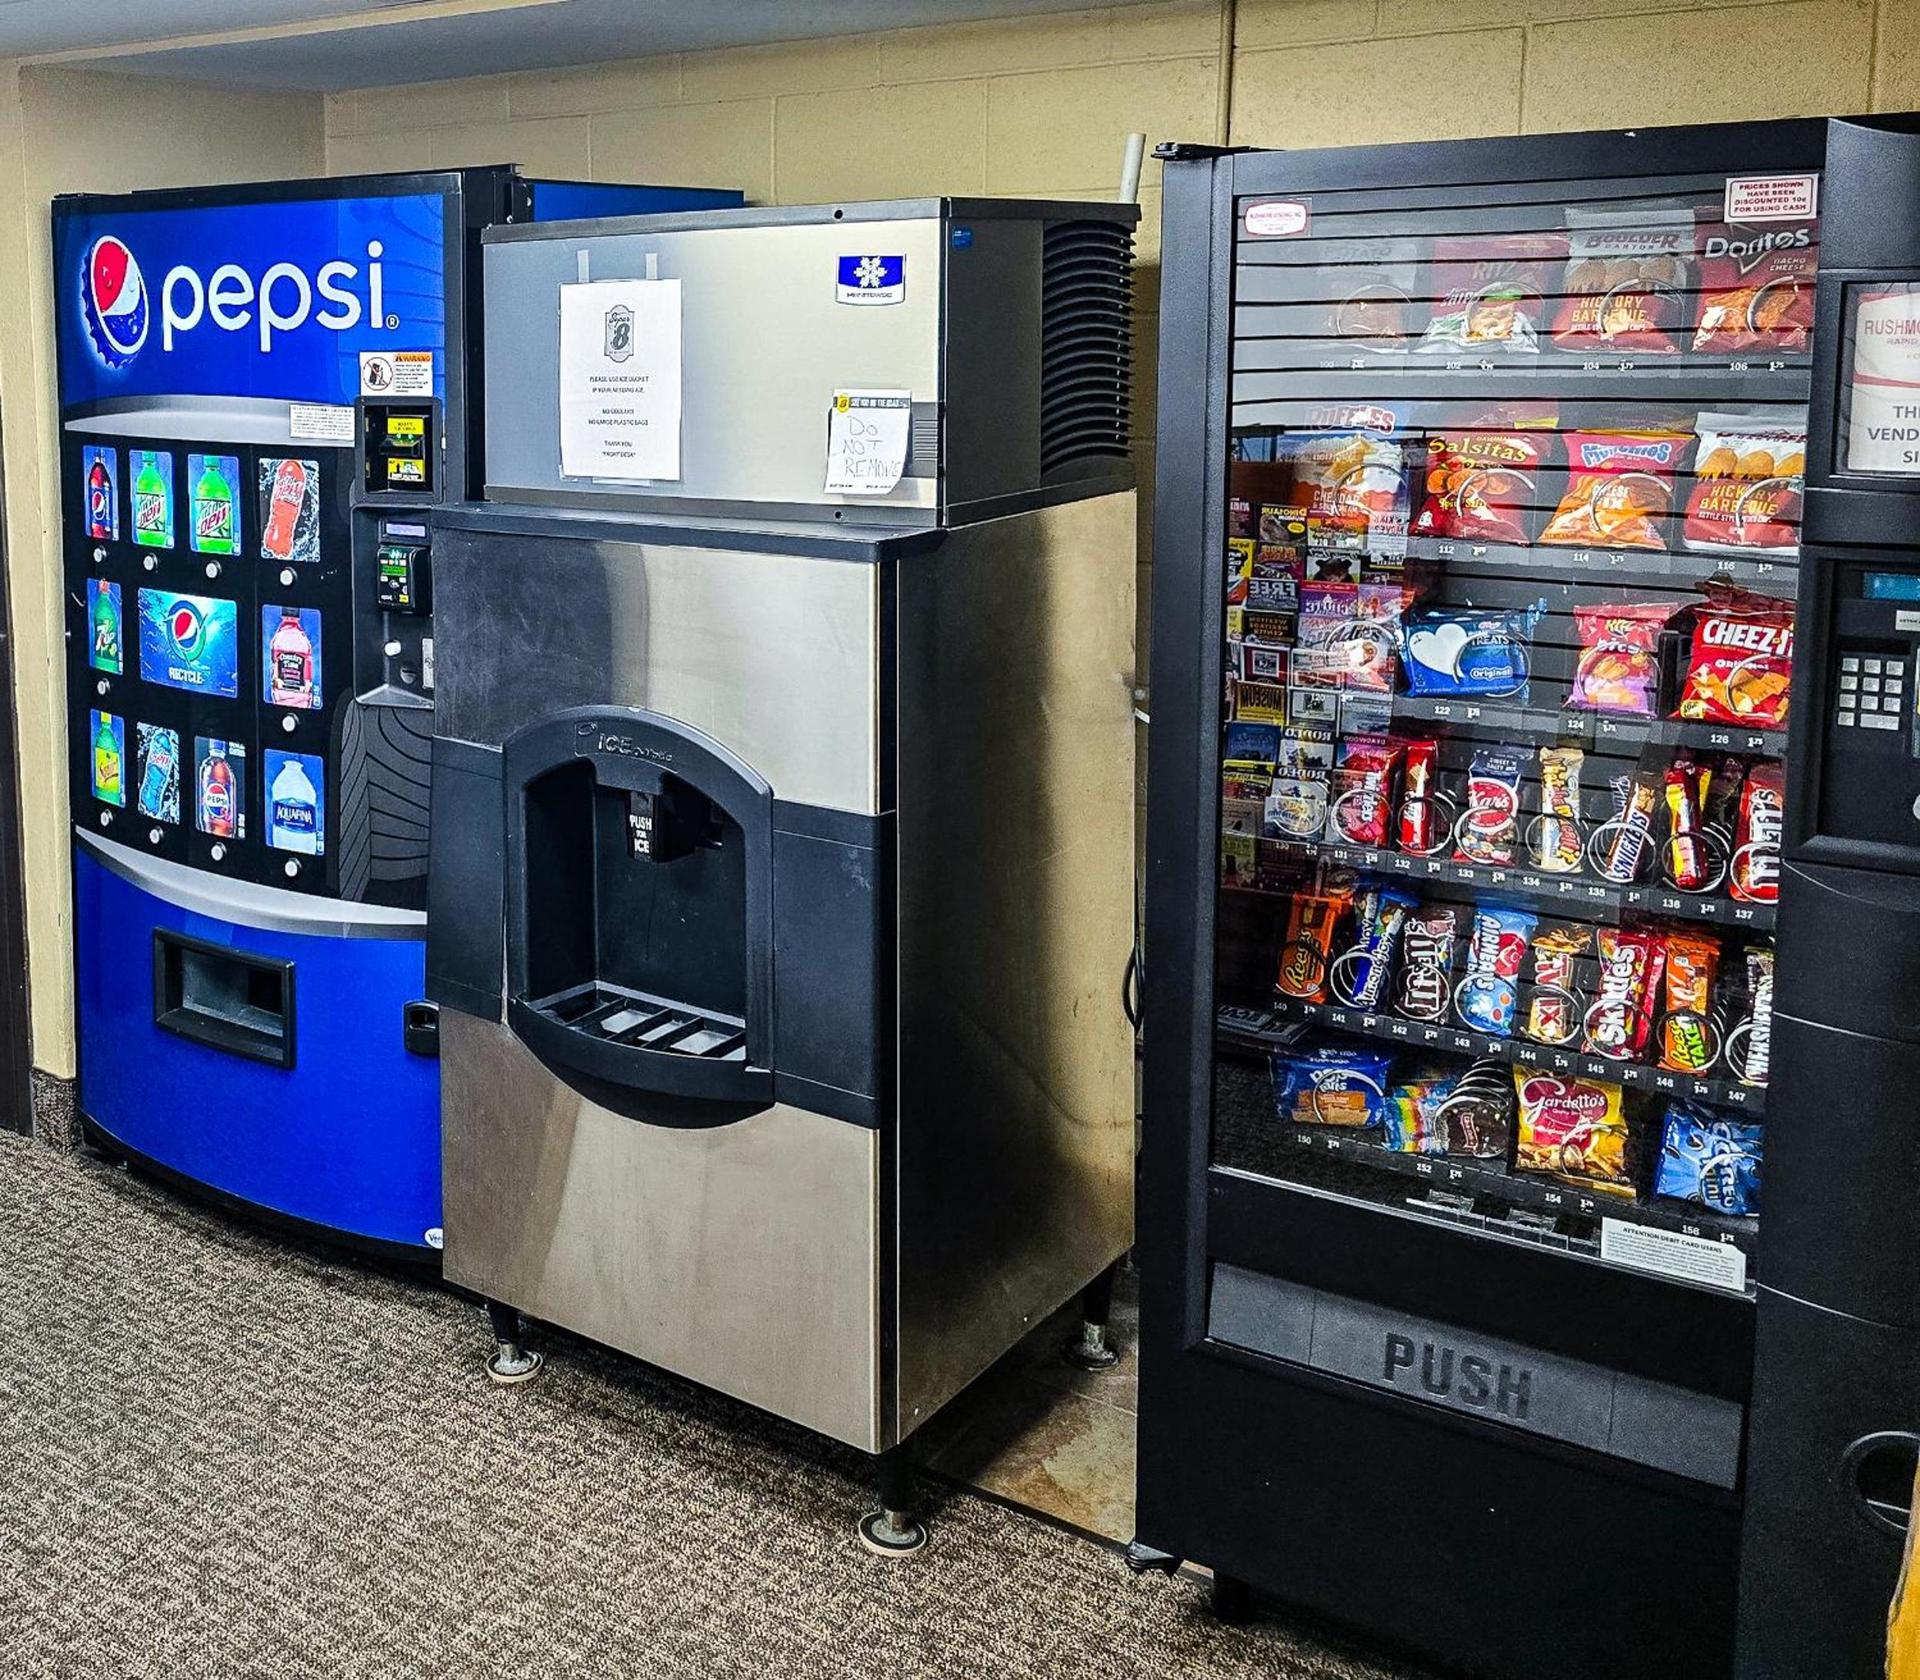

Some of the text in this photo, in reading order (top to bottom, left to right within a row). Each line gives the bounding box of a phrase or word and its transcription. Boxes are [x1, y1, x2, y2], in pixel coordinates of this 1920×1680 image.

[1739, 181, 1804, 191] PRICES SHOWN
[1734, 197, 1790, 206] DISCOUNTED
[1753, 205, 1781, 213] USING
[1782, 204, 1807, 212] CASH
[1704, 228, 1811, 259] Doritos
[161, 239, 385, 353] pepsi
[1580, 295, 1645, 309] HICORY
[1571, 308, 1648, 322] BAREQUE
[612, 322, 631, 351] 8
[1445, 360, 1462, 370] 102
[1582, 361, 1600, 371] 104
[1729, 361, 1748, 371] 106
[1892, 405, 1920, 419] TH
[847, 415, 878, 436] Do
[843, 438, 883, 456] NOT
[1428, 436, 1528, 462] Salsitas
[1313, 488, 1361, 504] CHEDAR
[1710, 484, 1777, 502] HICKRY
[1438, 545, 1455, 555] 112
[1572, 552, 1589, 562] 114
[1717, 561, 1736, 571] 116
[1470, 634, 1510, 647] TREATS
[1714, 658, 1770, 671] Orinal
[168, 666, 205, 685] RECYCLE
[1472, 667, 1514, 680] Original
[1434, 705, 1451, 715] 122
[1567, 719, 1585, 730] 124
[1710, 733, 1729, 745] 126
[1361, 770, 1382, 823] Twizlers
[275, 805, 313, 825] AQUAFINA
[629, 813, 653, 831] PUSH
[633, 838, 650, 853] ICE
[1613, 806, 1649, 880] SNICKERS
[1334, 850, 1348, 860] 131
[1394, 859, 1411, 869] 132
[1457, 868, 1475, 879] 133
[1522, 876, 1541, 887] 134
[1588, 886, 1606, 897] 135
[1735, 909, 1753, 920] 137
[1474, 914, 1503, 993] AIRHEADS
[1597, 946, 1636, 1046] Skittles
[1331, 1012, 1347, 1024] 141
[1391, 1024, 1408, 1035] 142
[1454, 1036, 1471, 1048] 143
[1686, 1022, 1706, 1069] TAKE
[1519, 1049, 1537, 1061] 144
[1587, 1062, 1605, 1075] 145
[1520, 1076, 1606, 1126] Gardetto's
[1727, 1089, 1746, 1102] 147
[1297, 1134, 1312, 1146] 150
[1416, 1162, 1433, 1174] 152
[1544, 1191, 1562, 1206] 154
[1622, 1226, 1724, 1255] ATTENTION DEBIT CARD USERS
[1382, 1330, 1534, 1424] PUSH
